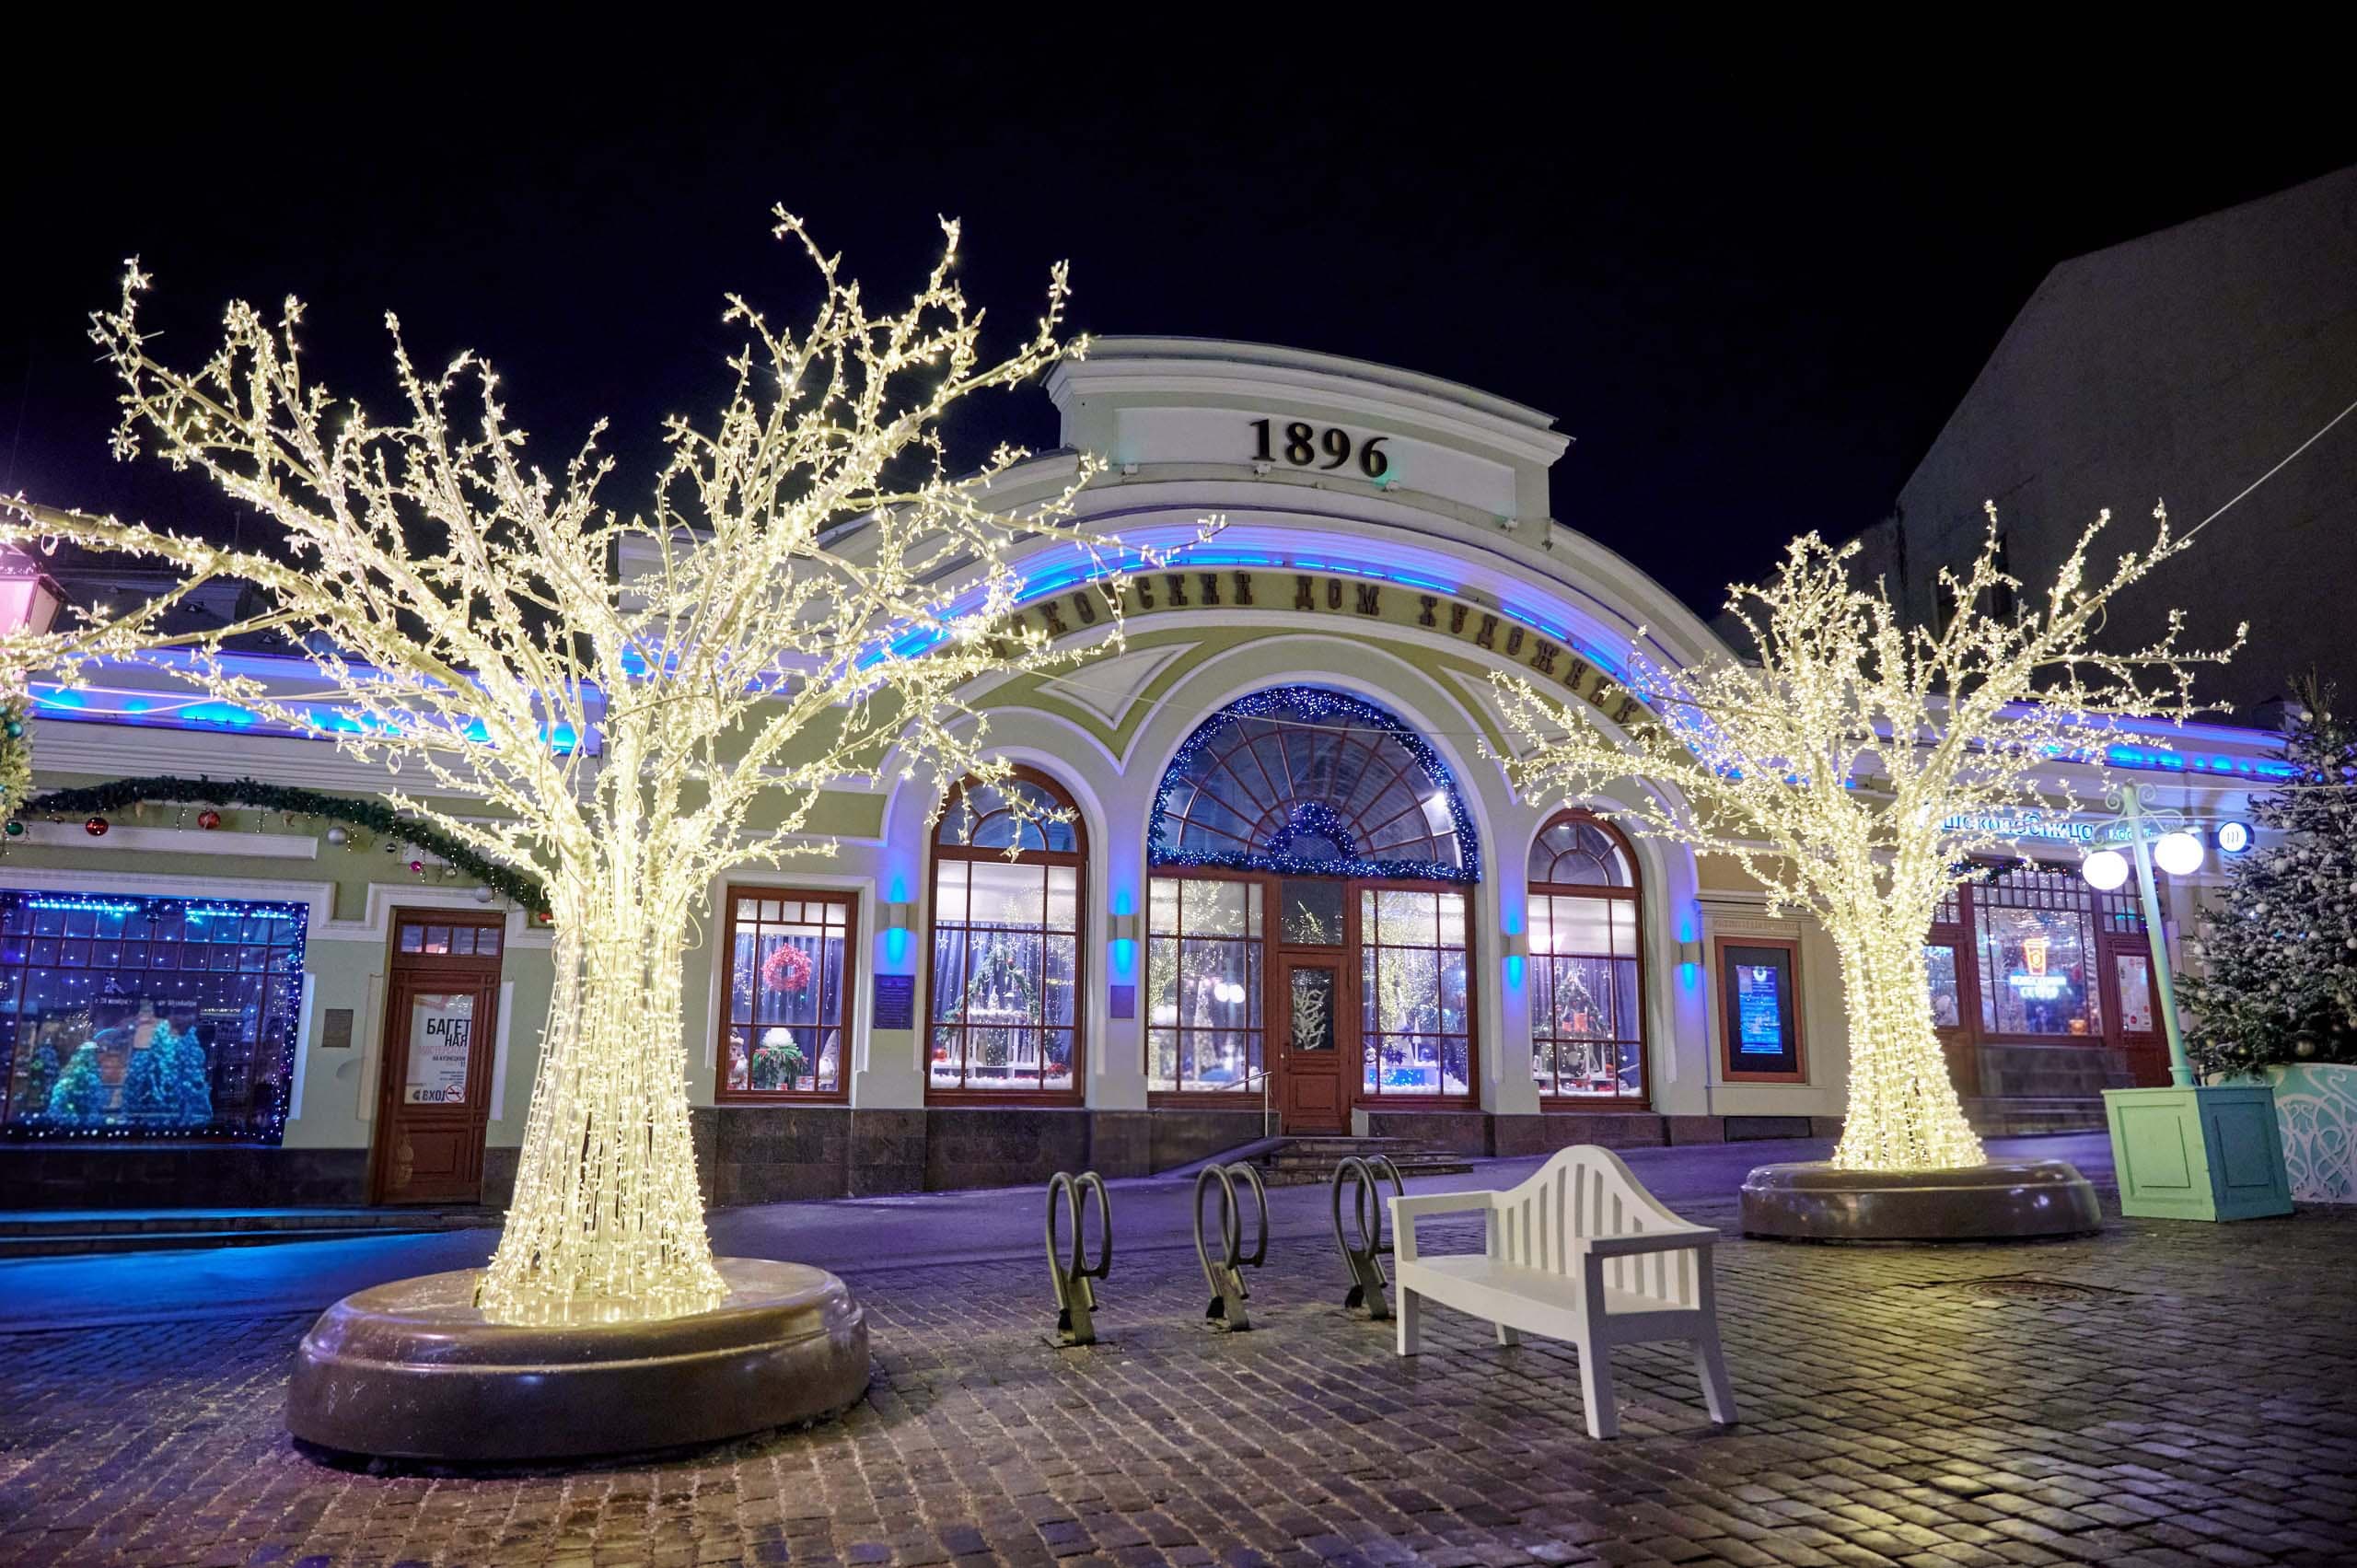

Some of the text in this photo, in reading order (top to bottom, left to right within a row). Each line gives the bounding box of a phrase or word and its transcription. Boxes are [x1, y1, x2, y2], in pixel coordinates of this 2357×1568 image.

[1248, 418, 1390, 479] 1896
[1295, 574, 1381, 617] ДОМ
[426, 1017, 472, 1036] БАГЕТ
[444, 1034, 468, 1047] НАЯ
